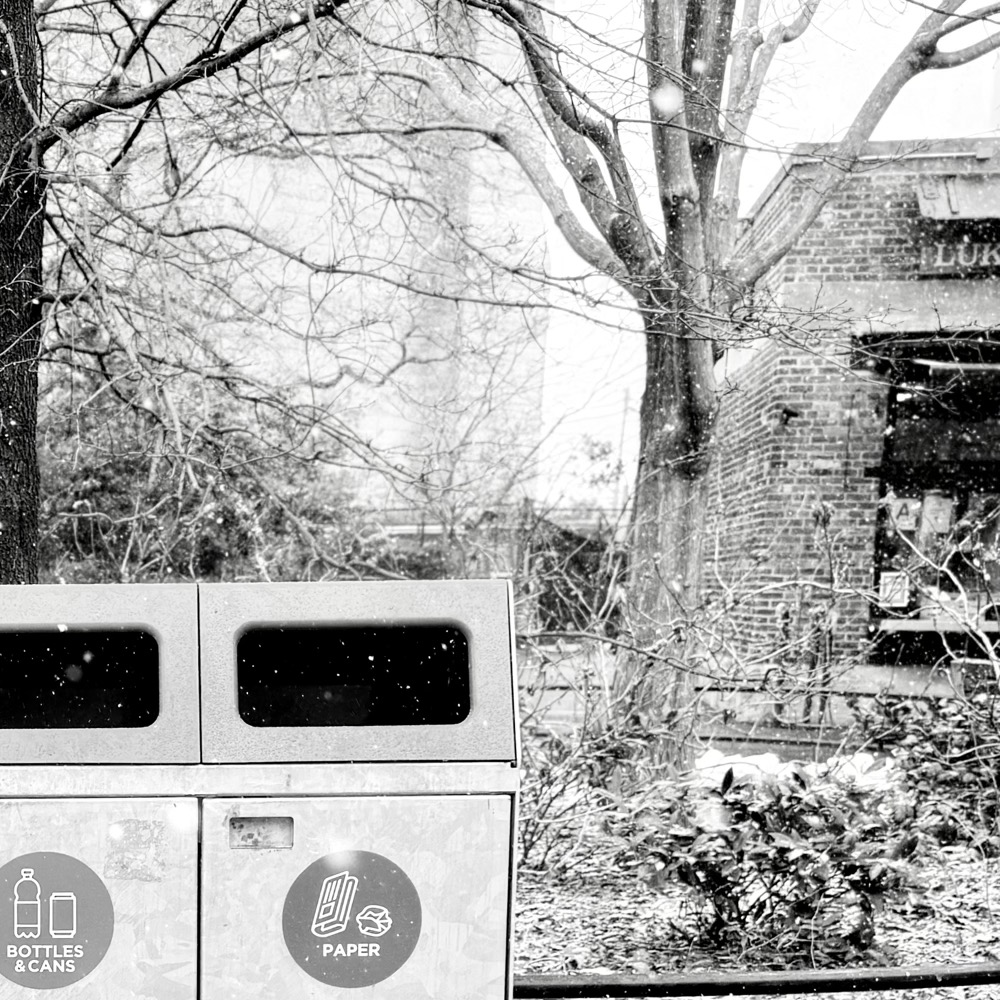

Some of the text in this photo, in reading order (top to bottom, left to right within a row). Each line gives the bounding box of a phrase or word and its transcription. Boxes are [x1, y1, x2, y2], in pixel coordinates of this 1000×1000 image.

[934, 242, 1000, 267] LUK
[6, 944, 84, 958] BOTTLES
[322, 943, 381, 957] PAPER
